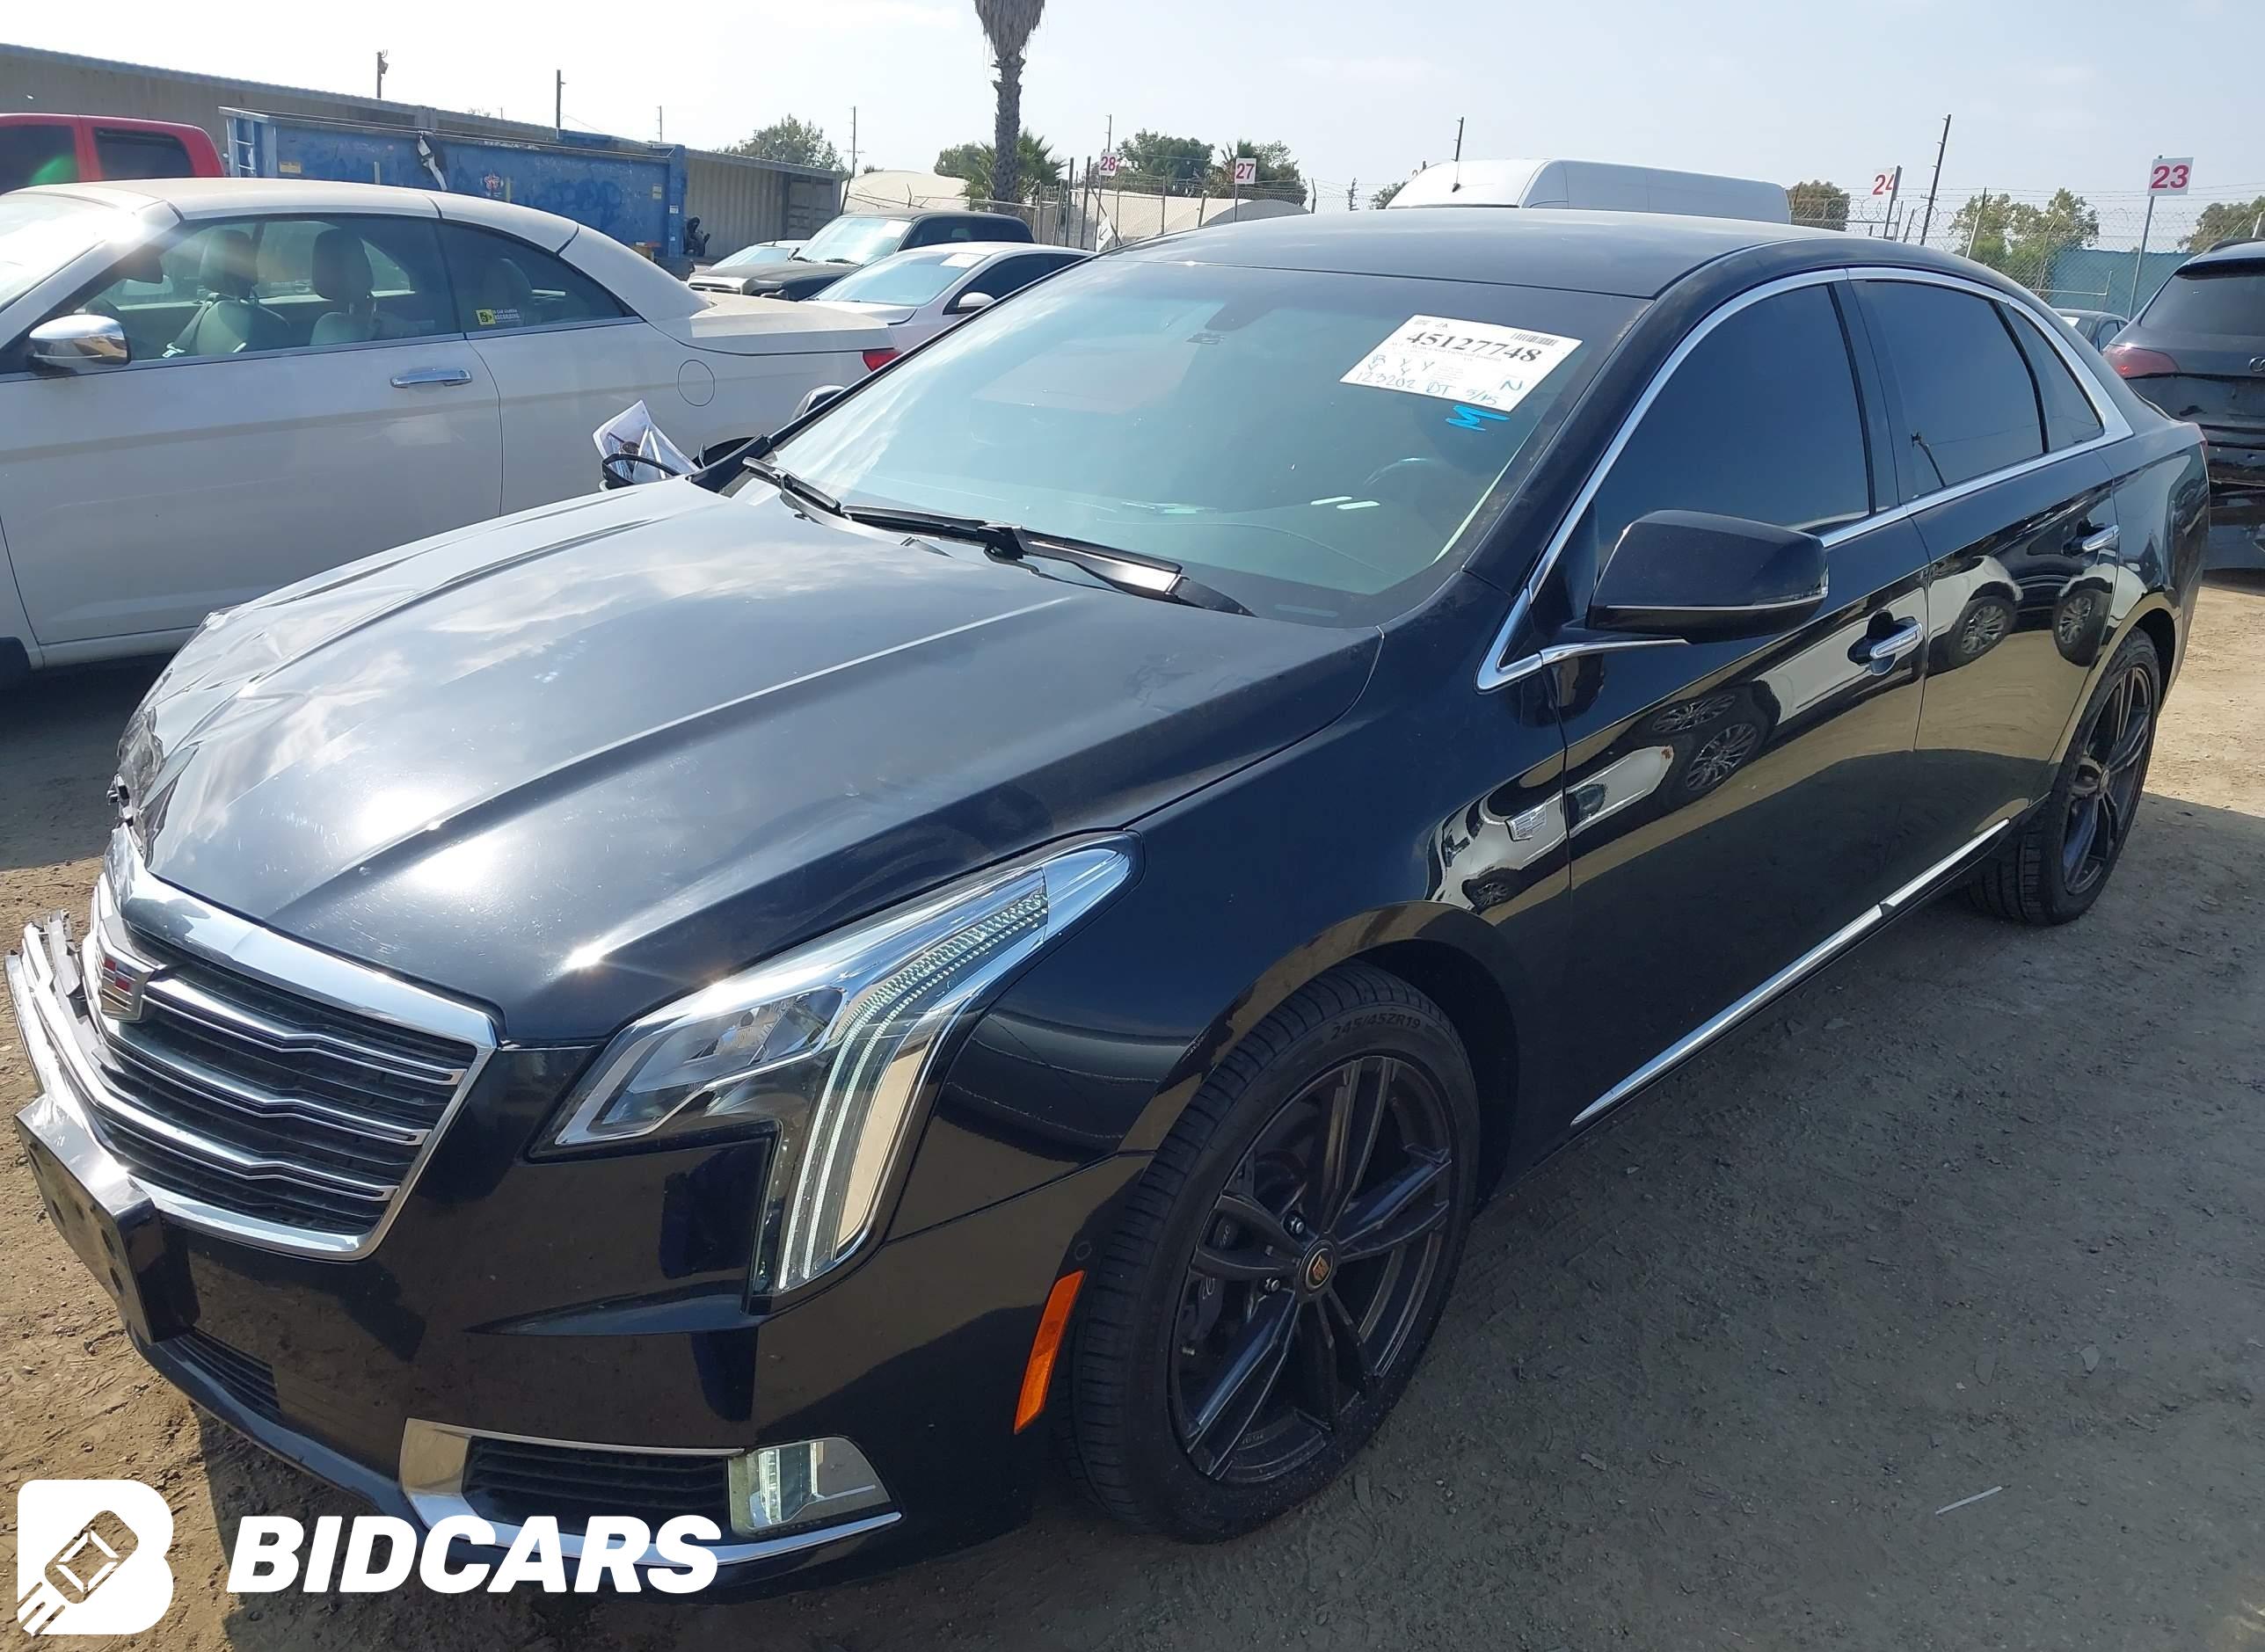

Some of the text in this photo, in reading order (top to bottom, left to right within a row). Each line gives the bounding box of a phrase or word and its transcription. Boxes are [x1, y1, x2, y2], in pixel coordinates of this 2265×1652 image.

[1100, 156, 1116, 171] 28
[1235, 164, 1256, 179] 27
[2151, 164, 2189, 189] 23
[1406, 331, 1543, 362] 45127748
[1330, 1012, 1422, 1041] 245/45ZR19
